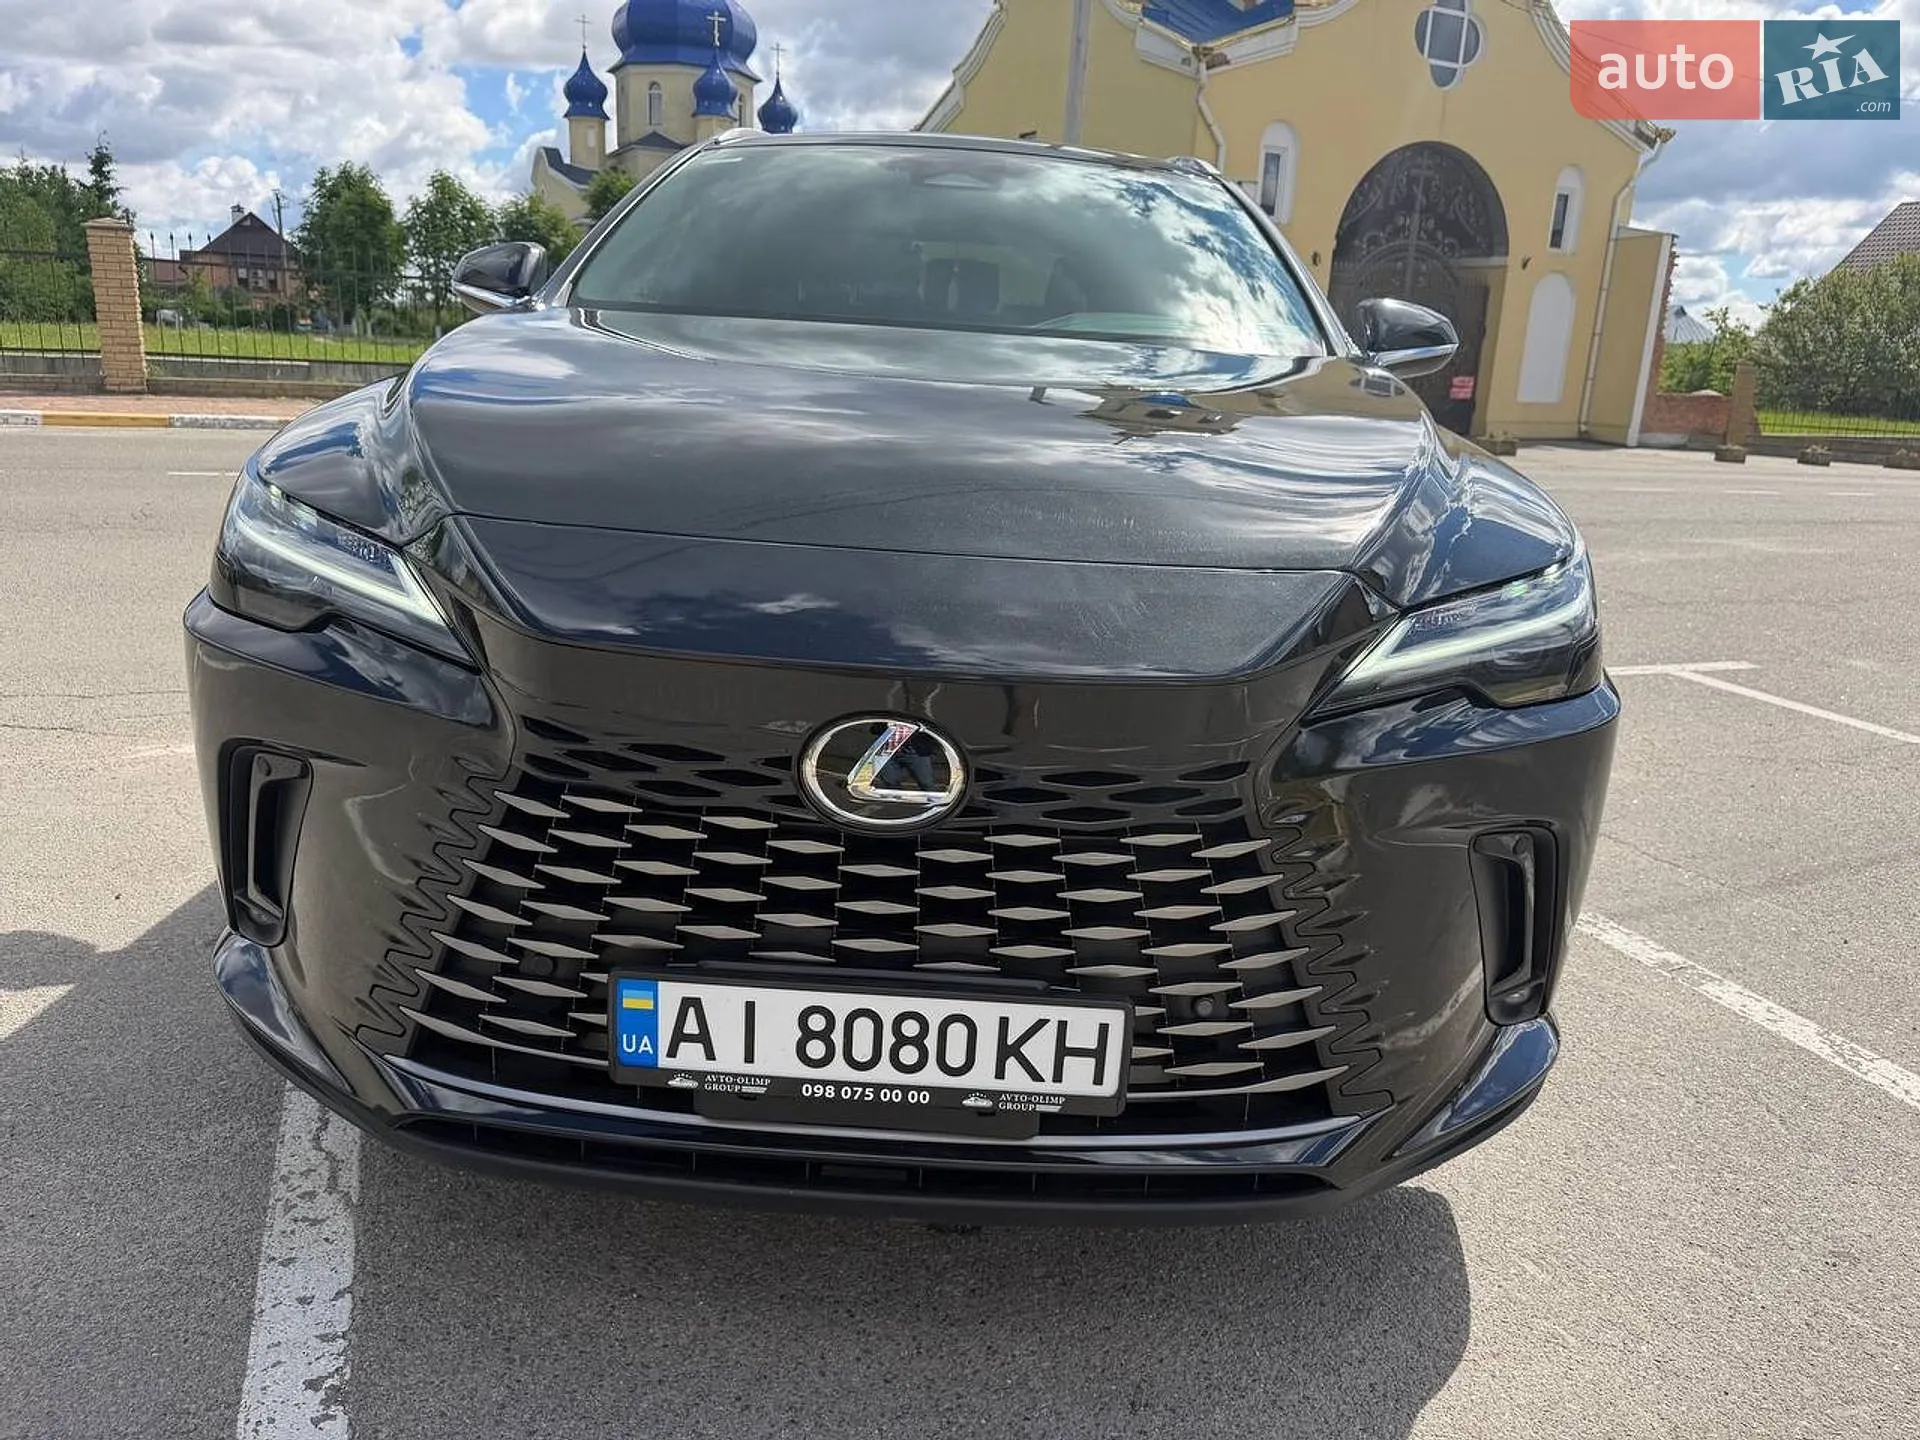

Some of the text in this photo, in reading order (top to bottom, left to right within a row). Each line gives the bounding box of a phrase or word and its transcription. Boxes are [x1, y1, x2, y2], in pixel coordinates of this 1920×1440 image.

[622, 1033, 654, 1055] UA
[666, 996, 1110, 1086] AI 8080 KH
[705, 1074, 771, 1086] AVTO-OLIMP
[704, 1083, 741, 1093] GROUP
[802, 1083, 930, 1104] 098 075 00 00
[1000, 1093, 1066, 1105] AVTO-OLIMP
[999, 1102, 1036, 1111] GROUP
